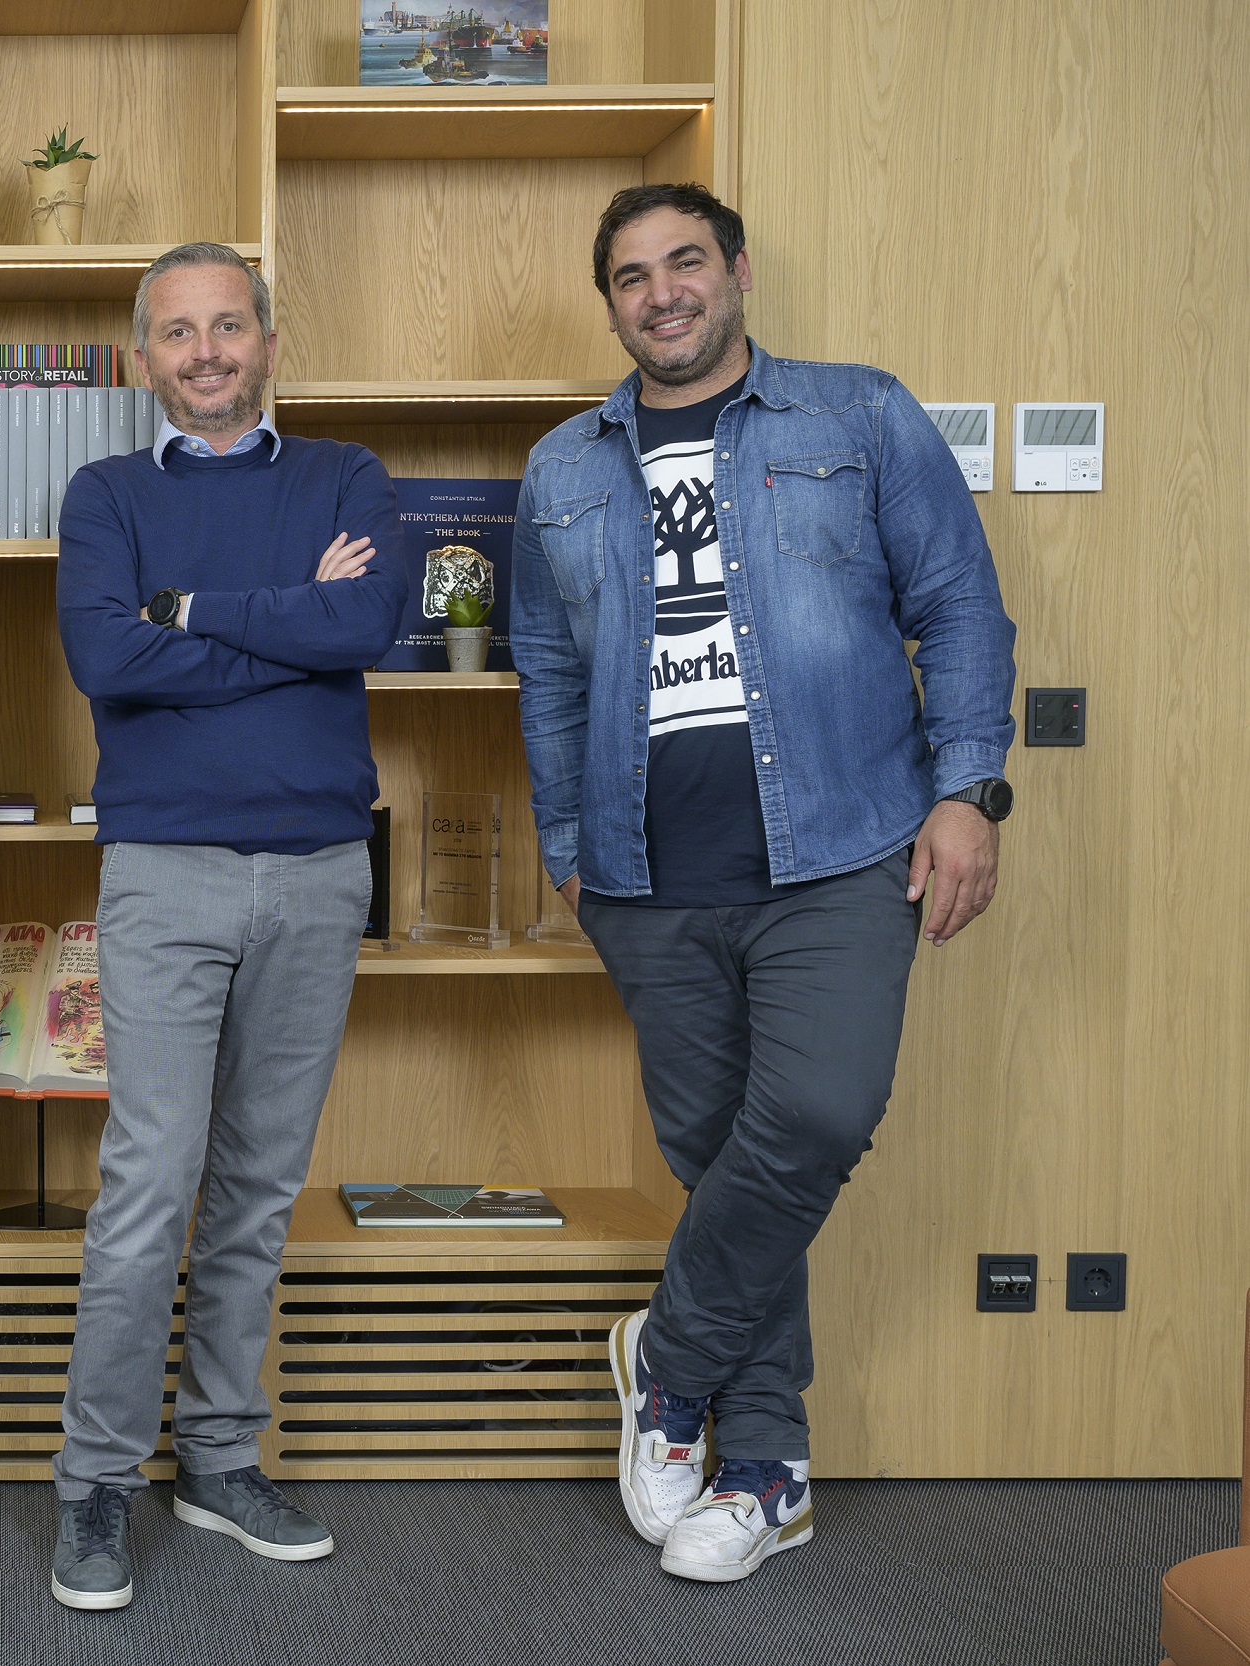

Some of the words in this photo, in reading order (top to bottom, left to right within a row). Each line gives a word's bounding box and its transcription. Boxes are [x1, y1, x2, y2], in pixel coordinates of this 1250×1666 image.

[44, 370, 88, 381] RETAIL
[400, 512, 460, 522] NTIKYTHERA
[435, 528, 454, 536] THE
[457, 529, 481, 537] BOOK
[650, 641, 741, 691] mberla
[4, 924, 46, 943] ΑΠΛΟ
[61, 923, 97, 942] ΚΡΙ
[666, 1447, 692, 1460] NIKE
[711, 1492, 740, 1501] NIKE
